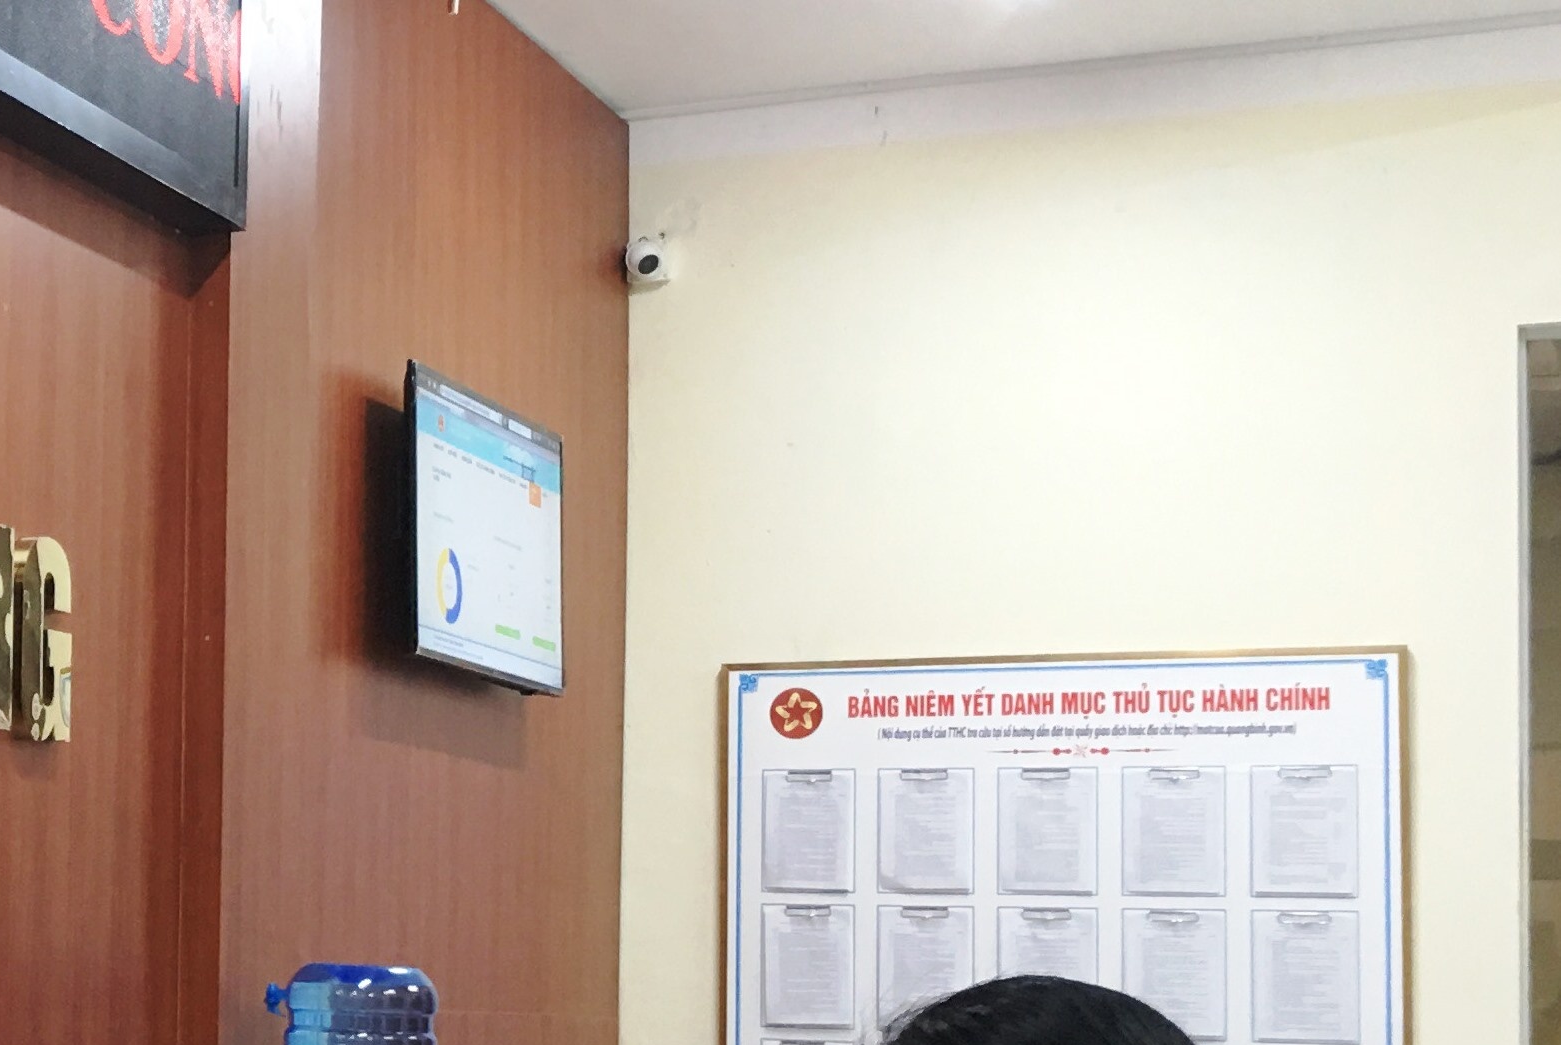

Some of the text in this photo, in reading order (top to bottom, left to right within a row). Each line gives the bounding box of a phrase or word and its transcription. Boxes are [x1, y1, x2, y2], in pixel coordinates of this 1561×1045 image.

[847, 681, 1331, 720] BẢNG NIÊM YẾT DANH MỤC THỦ TỤC HÀNH CHÍNH
